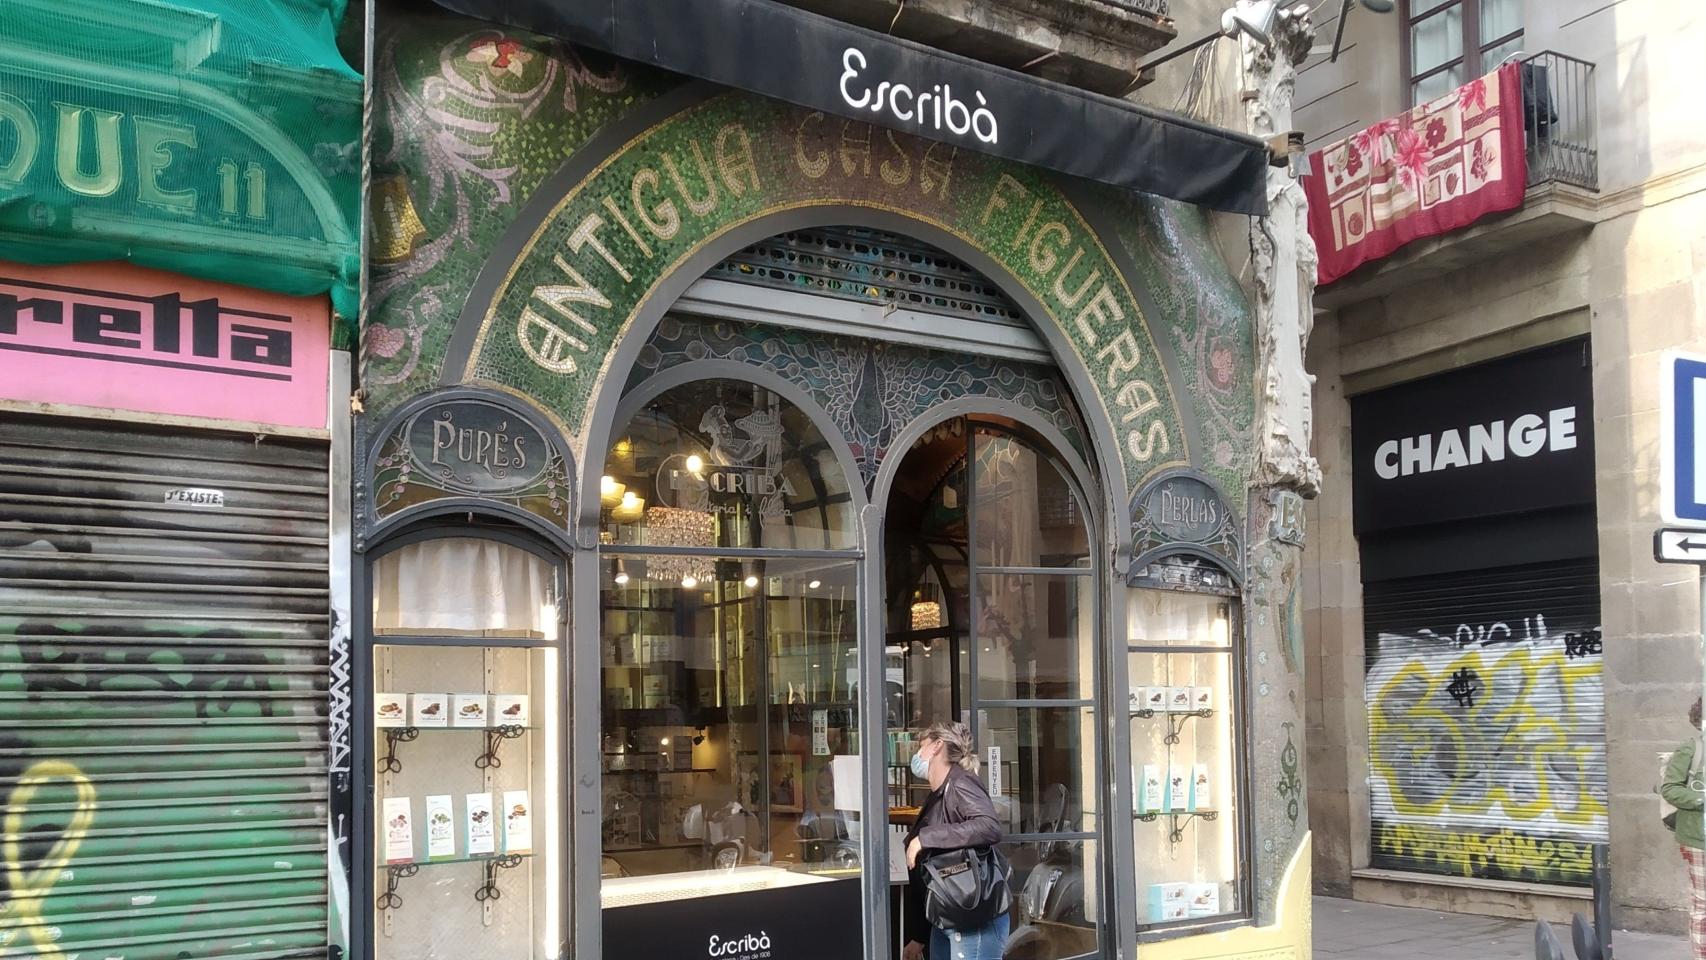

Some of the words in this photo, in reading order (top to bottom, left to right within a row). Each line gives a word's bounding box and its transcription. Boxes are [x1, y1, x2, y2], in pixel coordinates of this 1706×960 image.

[840, 47, 998, 144] Escribà
[217, 157, 267, 219] 11
[517, 123, 761, 374] ANTIGUA
[796, 111, 958, 200] CASA
[981, 173, 1170, 462] FIGUERAS
[1374, 406, 1577, 480] CHANGE
[1160, 484, 1216, 529] PERLAS
[708, 930, 771, 957] Escribà
